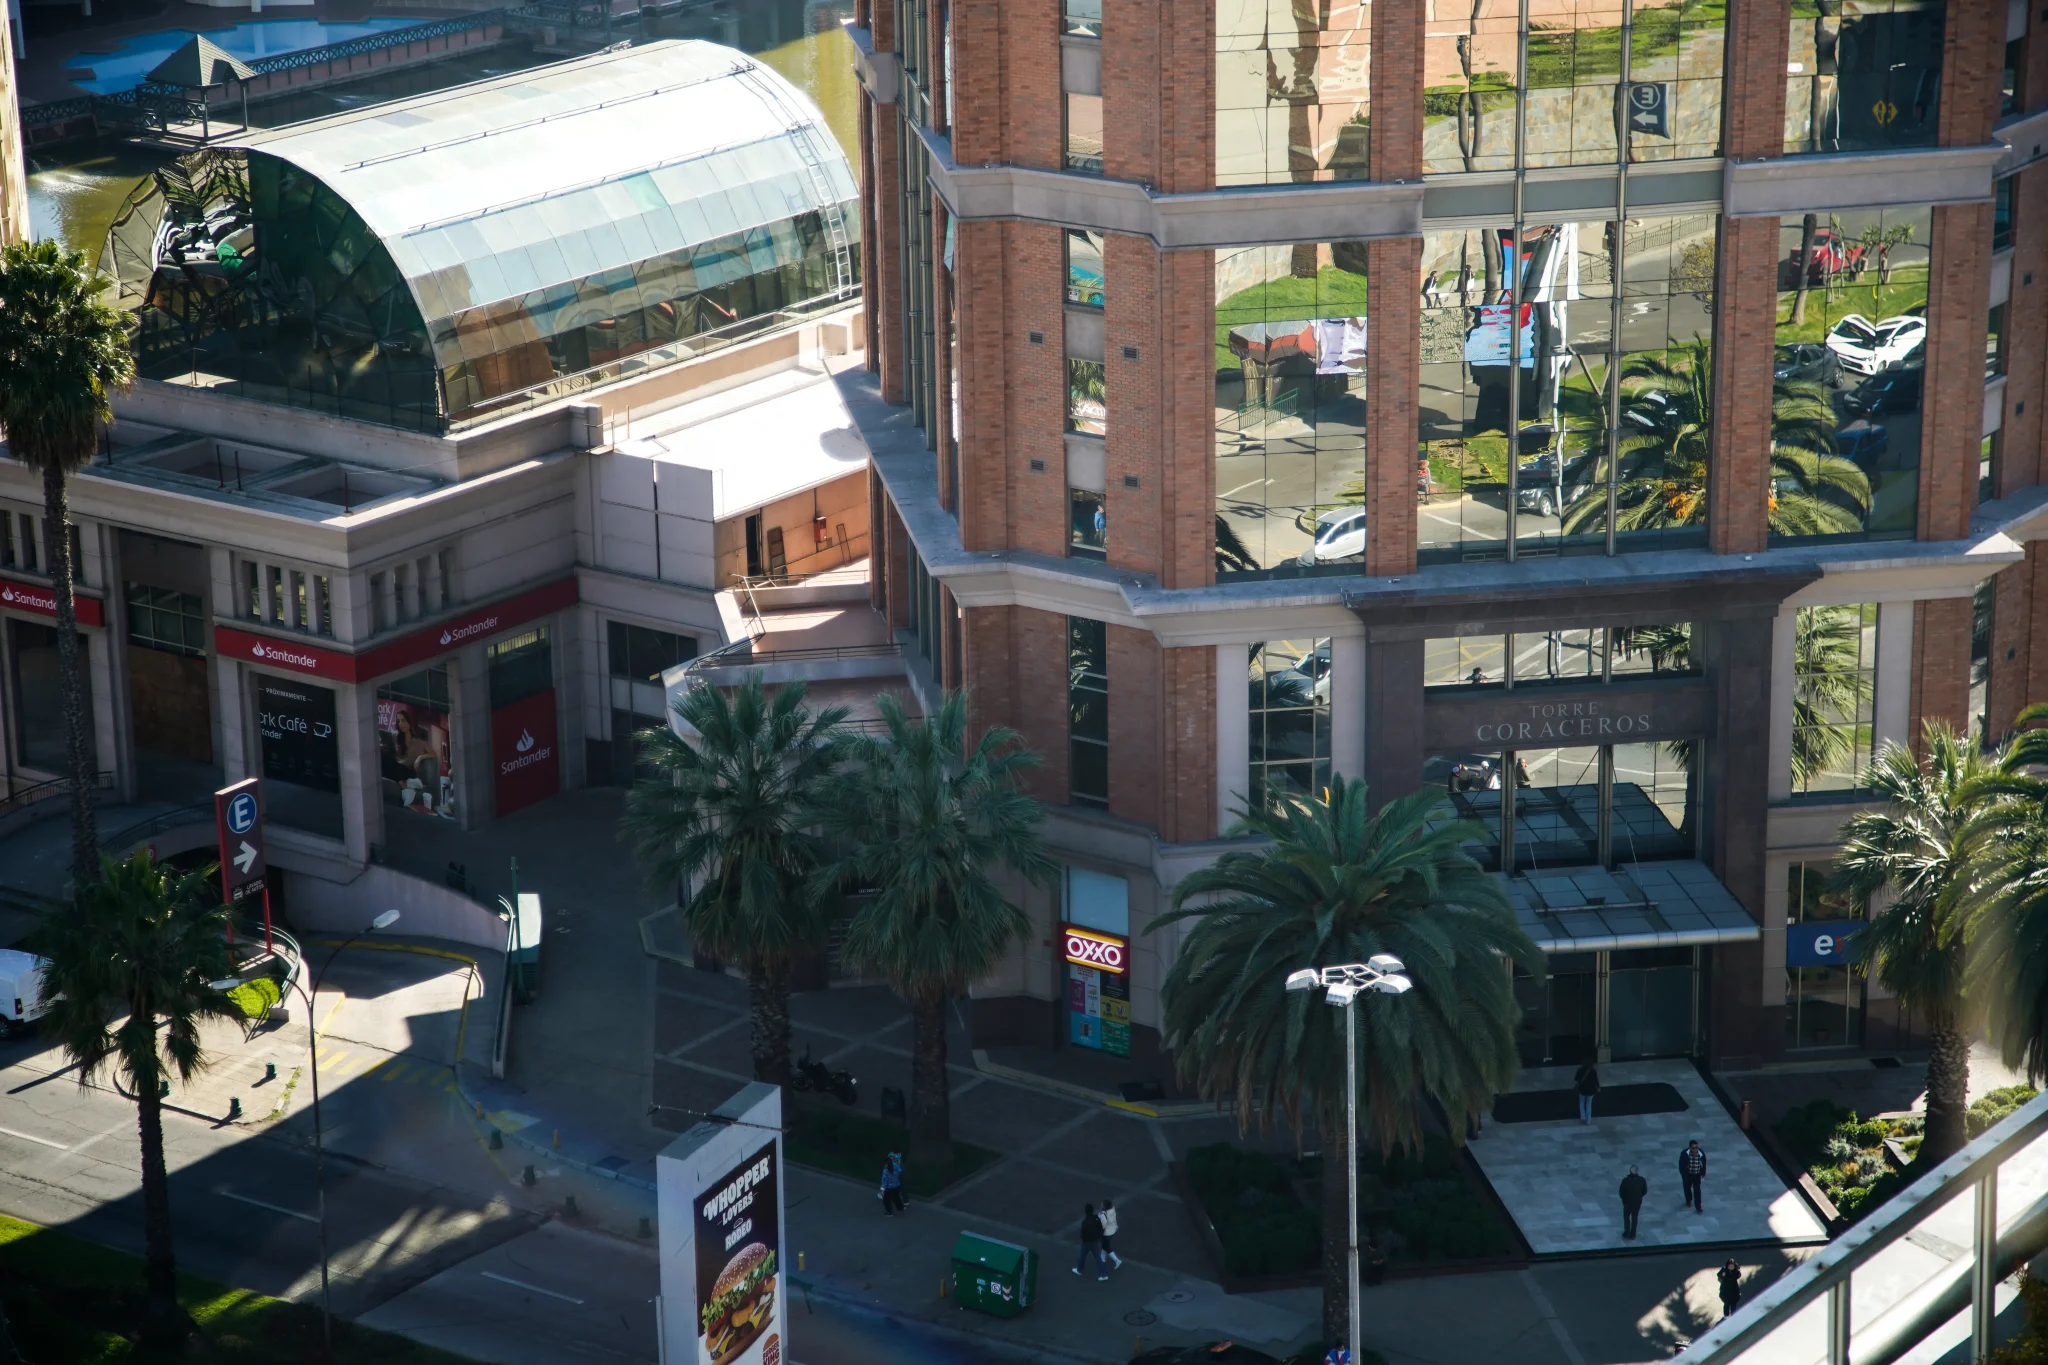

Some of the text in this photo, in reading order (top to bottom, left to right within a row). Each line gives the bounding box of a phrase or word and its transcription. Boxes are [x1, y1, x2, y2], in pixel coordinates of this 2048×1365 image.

[452, 616, 498, 641] Santander
[265, 647, 317, 668] Santander
[377, 702, 391, 714] ork
[1528, 701, 1598, 719] TORRE
[278, 714, 307, 734] Café
[1477, 714, 1650, 742] CORACEROS
[501, 745, 551, 775] Santander
[234, 796, 251, 830] E
[1067, 937, 1121, 966] OXXO
[703, 1157, 770, 1221] WHOPPER
[722, 1190, 753, 1226] LOVERS
[725, 1217, 753, 1252] RODEO
